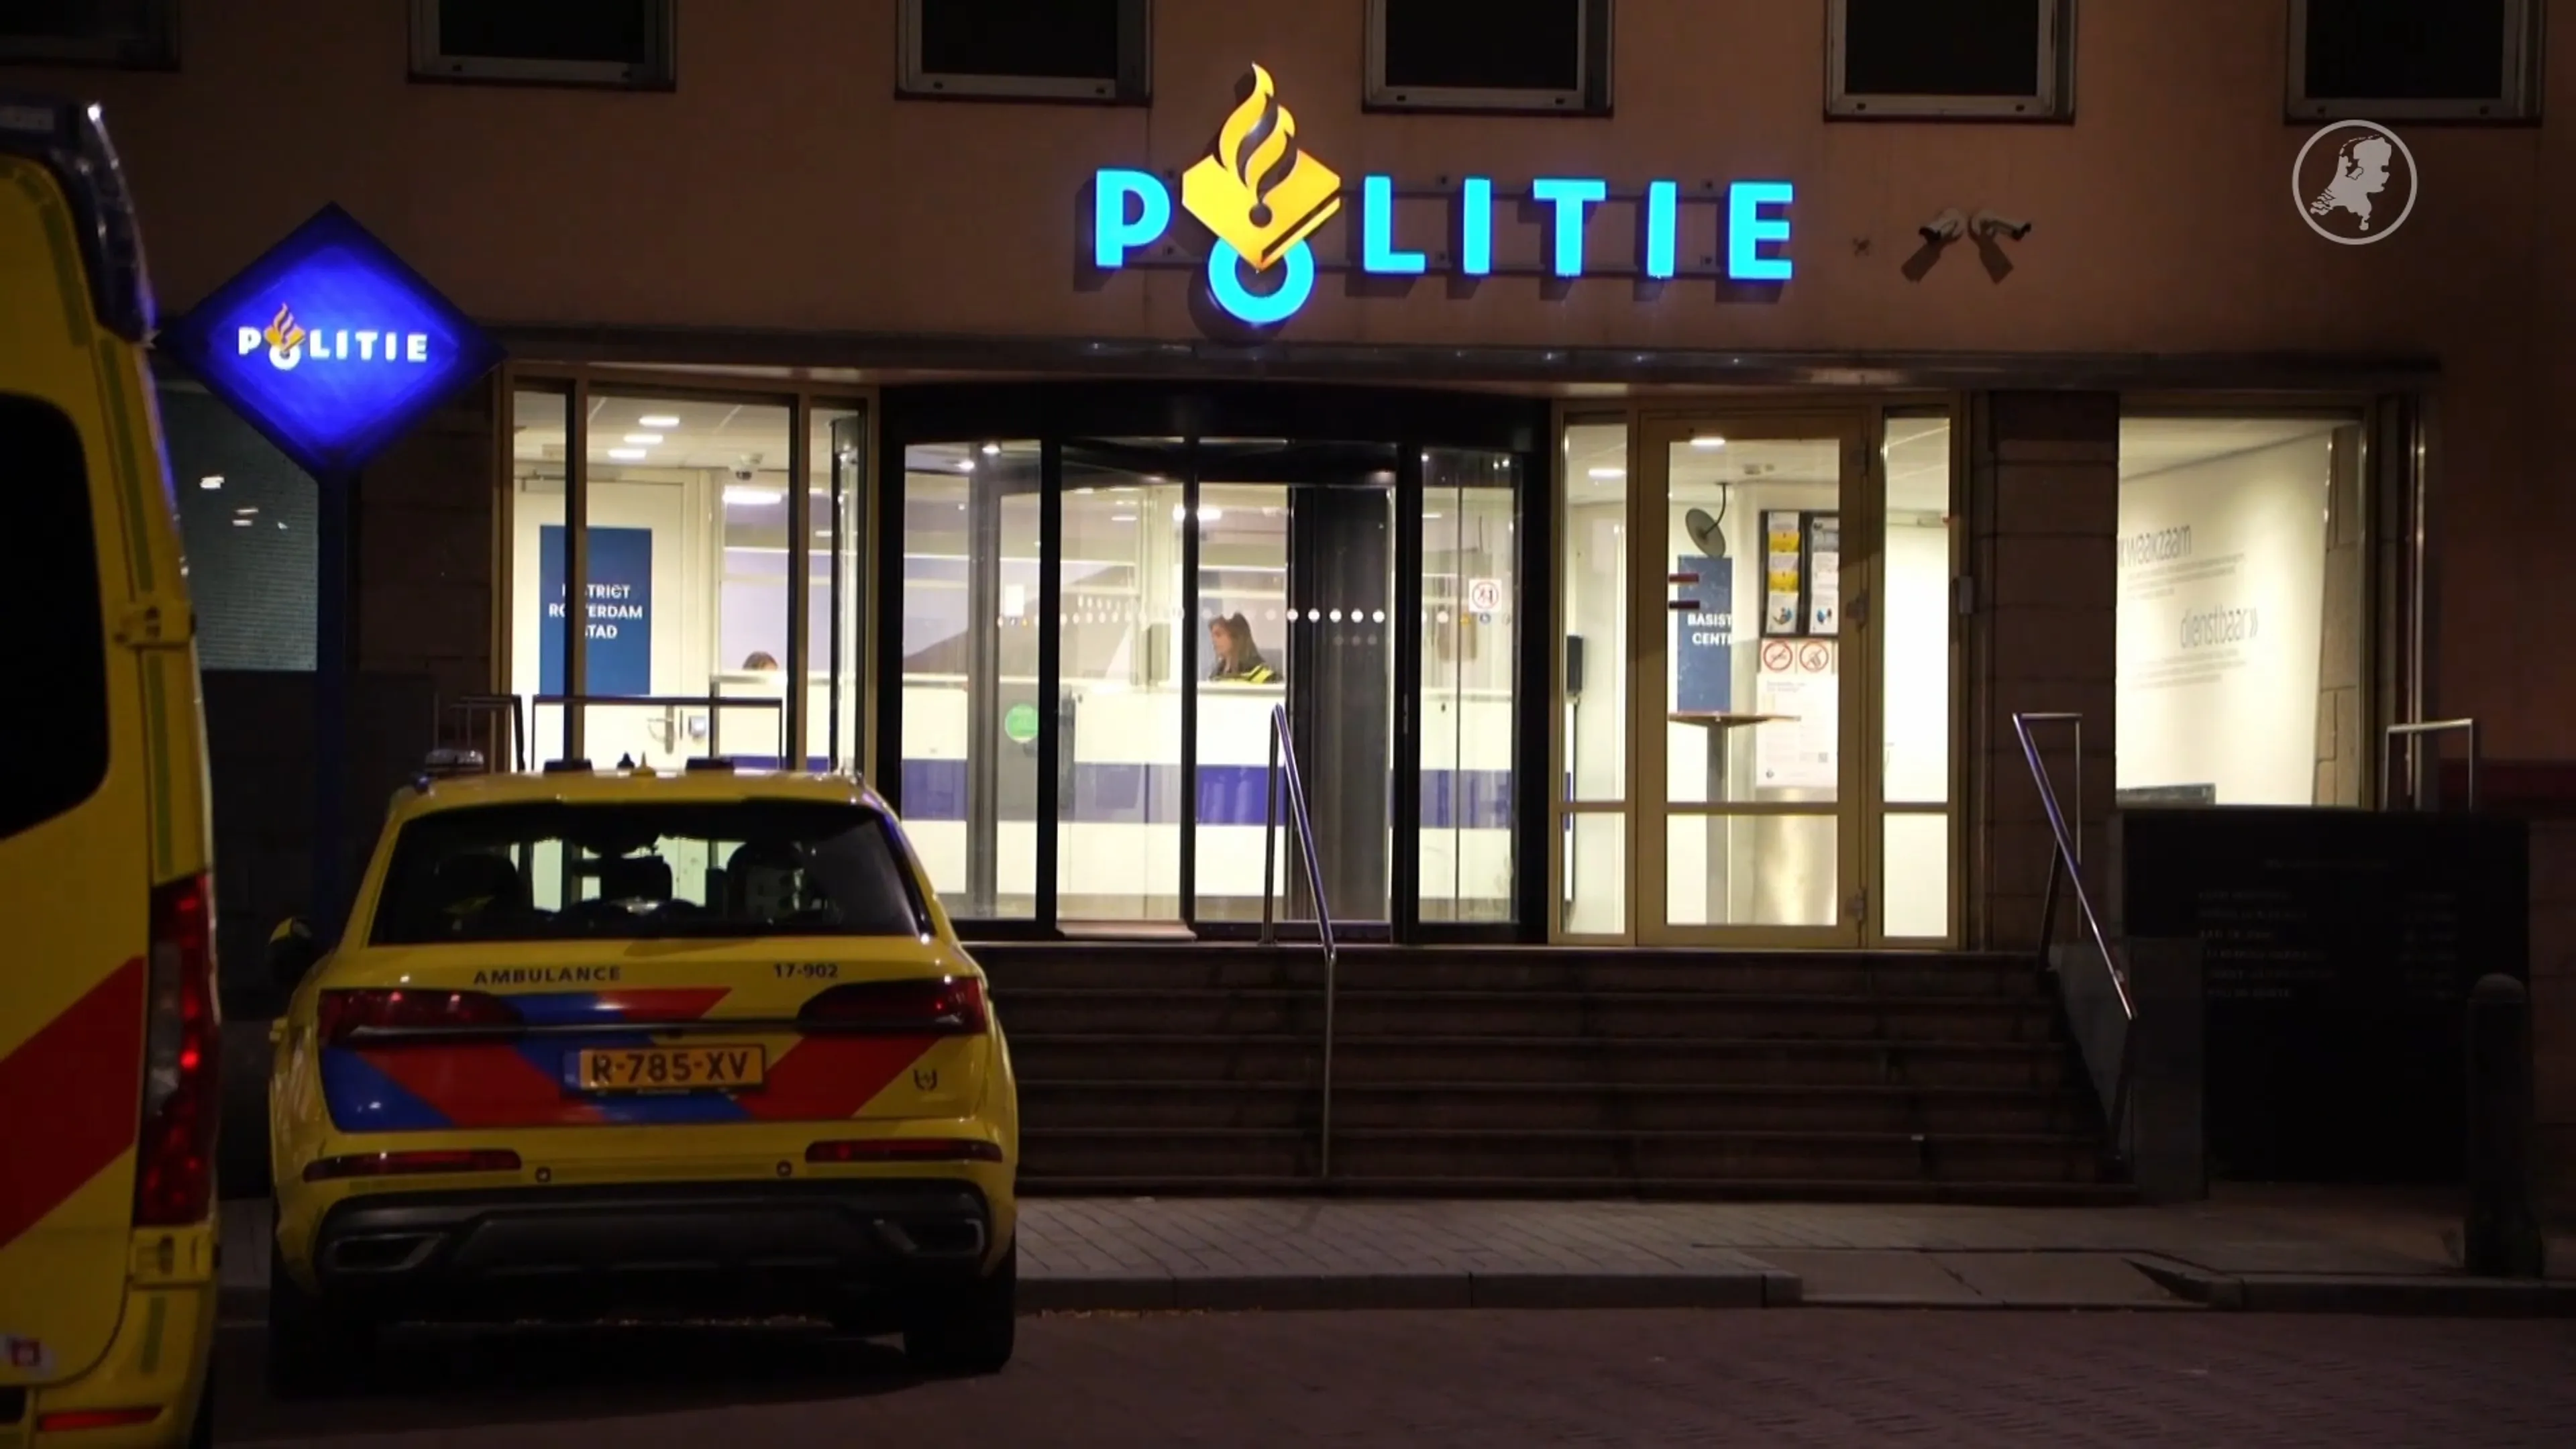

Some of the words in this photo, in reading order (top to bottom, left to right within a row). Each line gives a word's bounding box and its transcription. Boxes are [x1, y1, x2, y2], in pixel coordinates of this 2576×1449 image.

[1095, 168, 1793, 323] POLITIE
[238, 326, 427, 370] POLITIE
[562, 584, 631, 599] TRICT
[549, 603, 643, 619] ROERDAM
[585, 624, 618, 639] TAD
[474, 965, 621, 985] AMBULANCE
[773, 963, 839, 978] 17-902
[591, 1051, 749, 1083] R-785-XV
